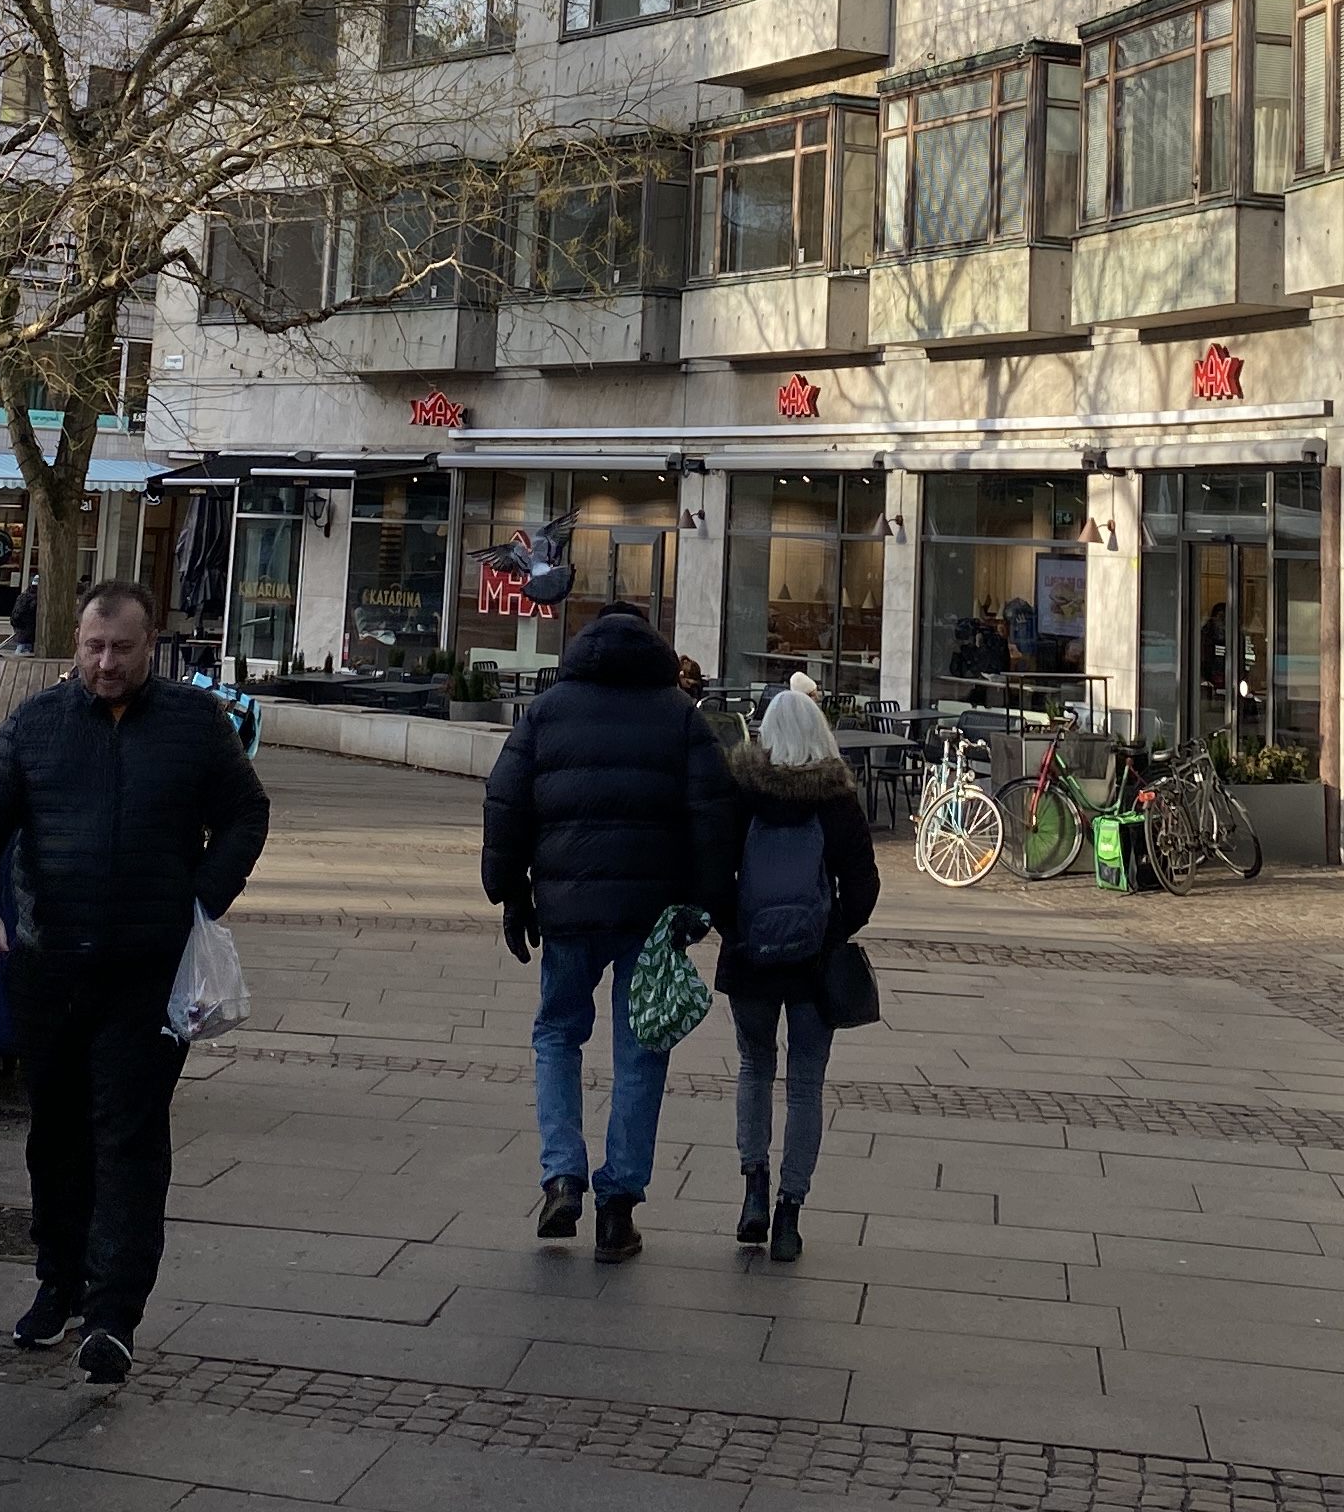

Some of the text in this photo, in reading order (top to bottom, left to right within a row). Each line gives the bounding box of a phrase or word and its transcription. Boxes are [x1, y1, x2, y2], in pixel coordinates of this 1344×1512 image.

[1194, 344, 1232, 397] MAX
[415, 391, 464, 428] MAX
[778, 374, 812, 416] MAX
[239, 580, 292, 599] KATARINA
[369, 589, 422, 608] KATARINA
